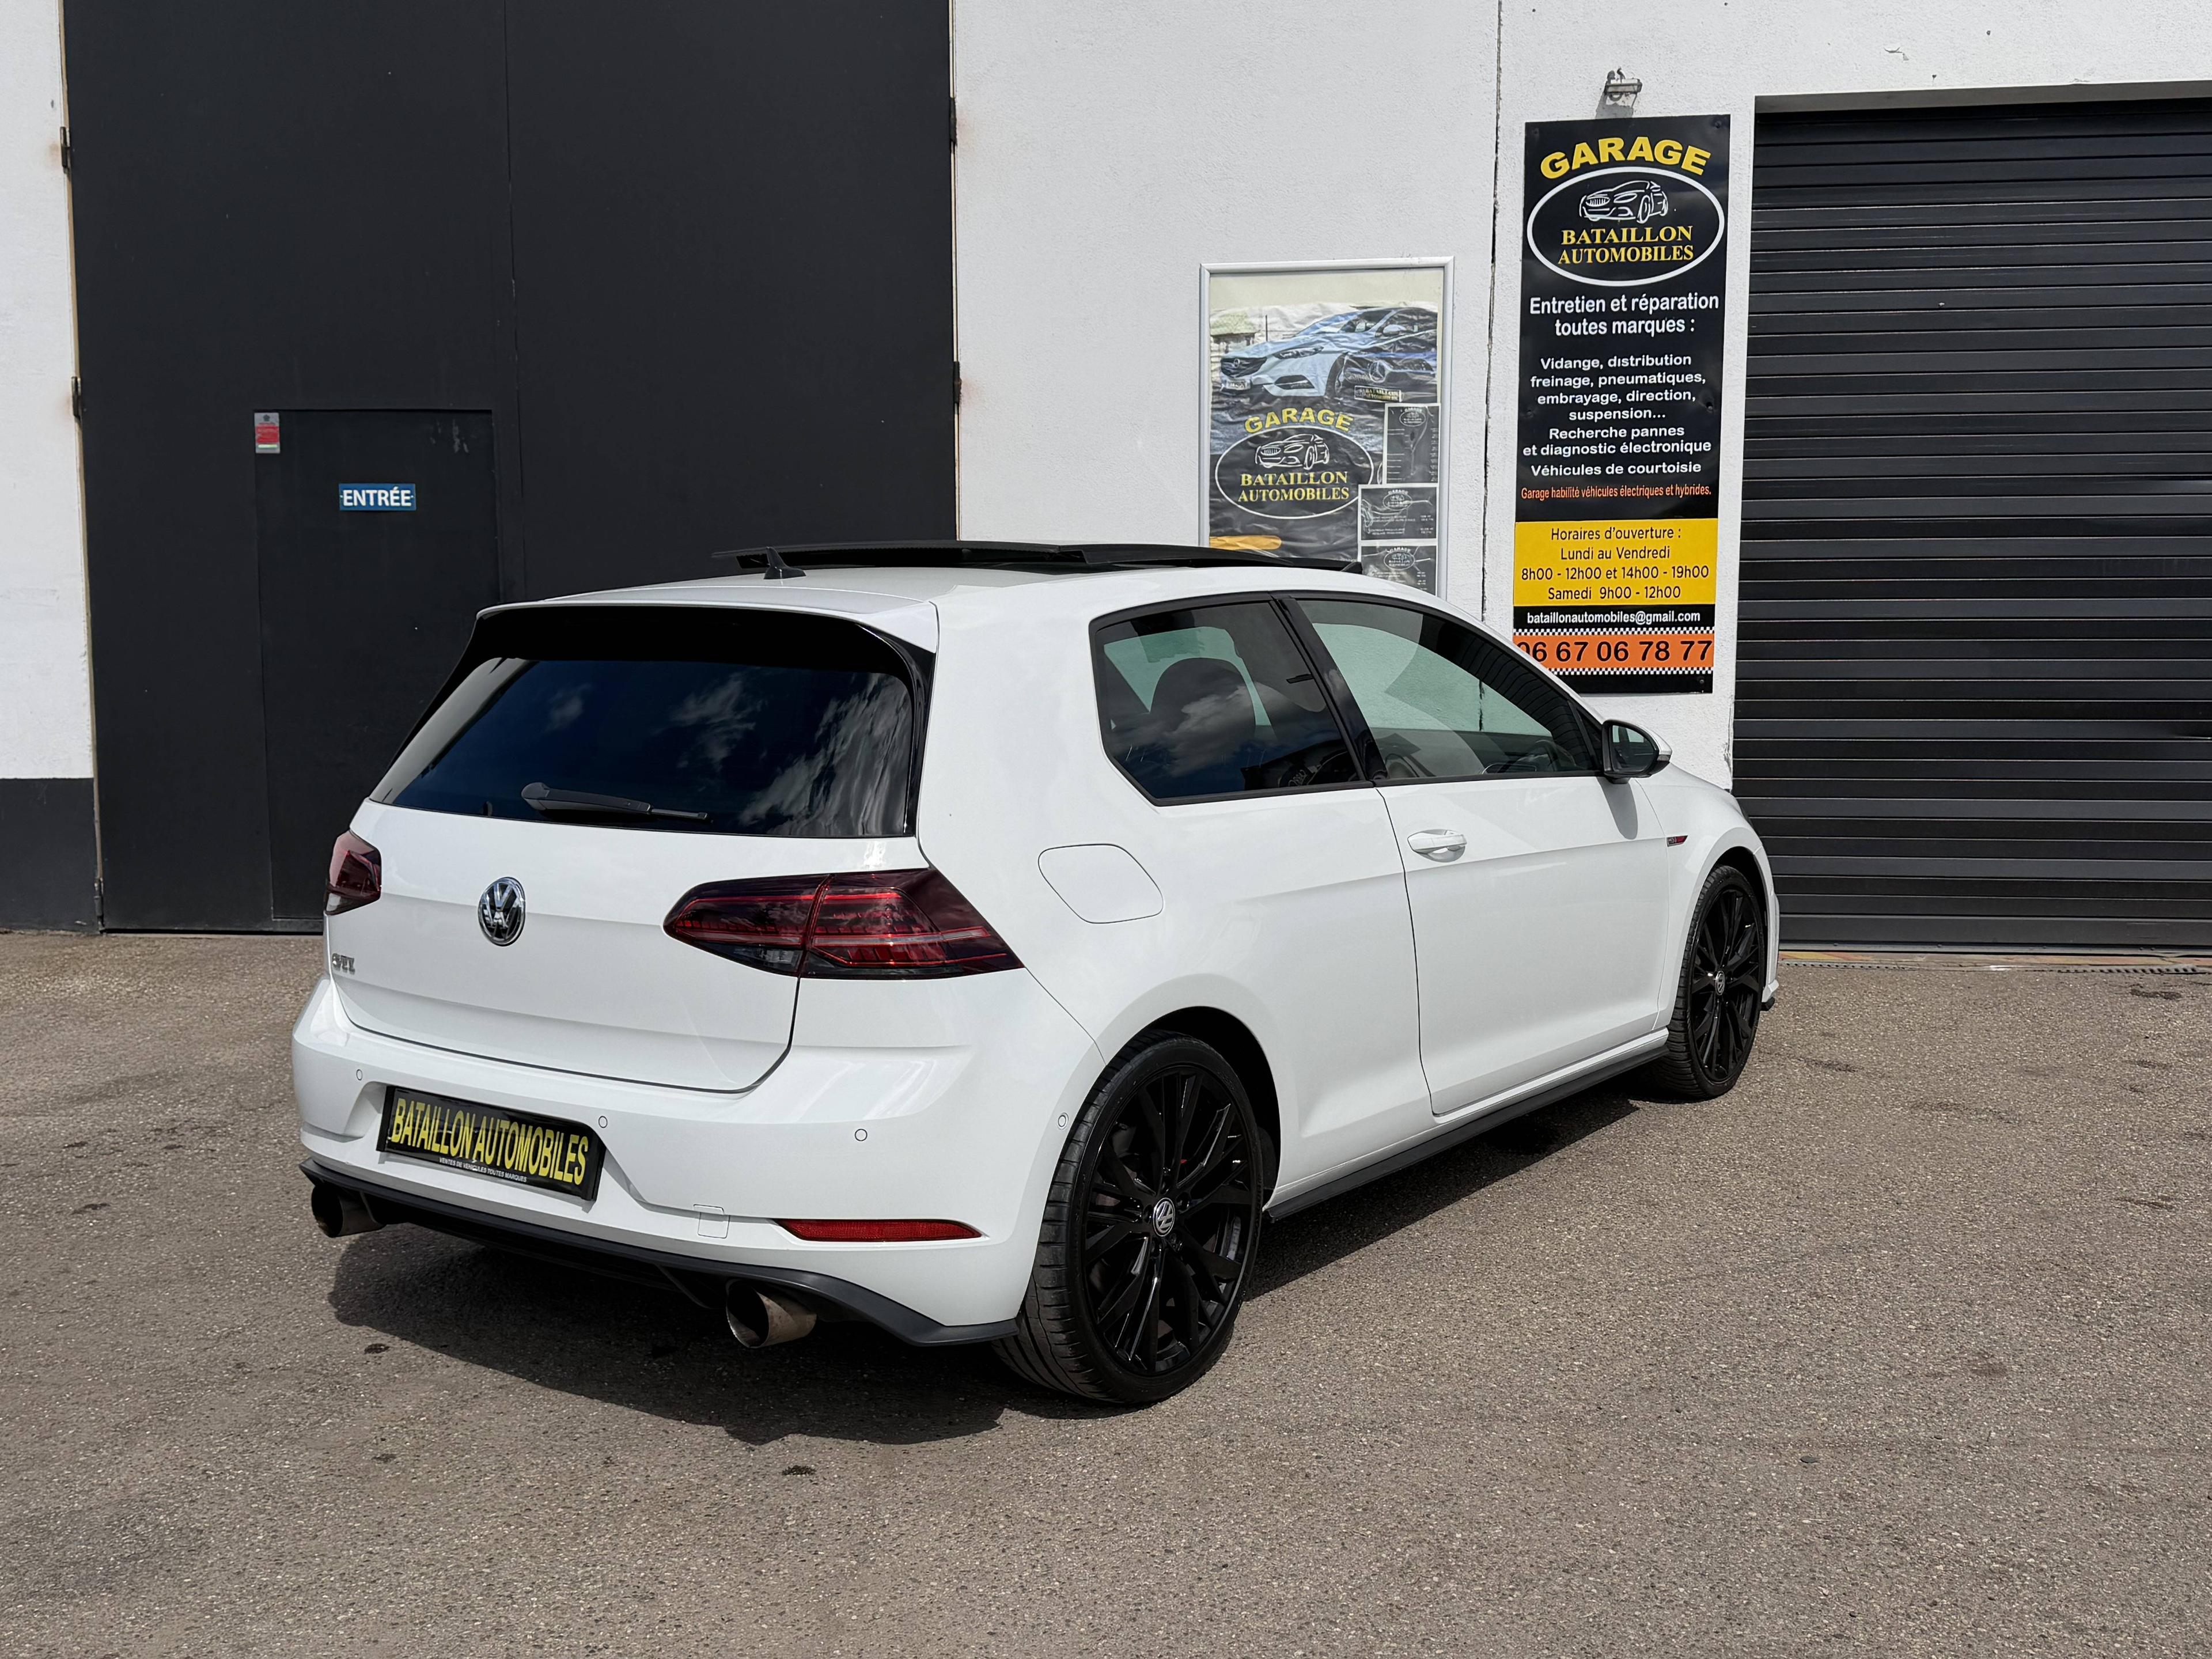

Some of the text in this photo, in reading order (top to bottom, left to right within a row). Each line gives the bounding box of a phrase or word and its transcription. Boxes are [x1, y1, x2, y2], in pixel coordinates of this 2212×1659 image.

[1540, 137, 1711, 179] GARAGE
[1561, 225, 1693, 245] BATAILLON
[1558, 245, 1694, 264] AUTOMOBILES
[1530, 293, 1719, 314] Entretien et réparation
[1555, 319, 1607, 336] toutes
[1612, 319, 1685, 338] marques
[1541, 354, 1691, 371] Vidange, distribution
[1531, 373, 1706, 388] freinage, pneumatiques,
[1537, 389, 1696, 406] embrayage, direction,
[1244, 407, 1354, 433] GARAGE
[1569, 408, 1666, 422] suspension...
[1549, 427, 1684, 440] Recherche pannes
[1523, 440, 1711, 457] et diagnostic électronique
[1531, 461, 1701, 476] Véhicules de courtoisie
[1240, 471, 1349, 486] BATAILLON
[343, 486, 411, 506] ENTRÉE
[1238, 487, 1349, 502] AUTOMOBILES
[1521, 484, 1711, 501] Garage habilité véhicules électriques et hybrides.
[1551, 527, 1600, 540] Horaires
[1560, 546, 1670, 560] Lundi au Vendredi
[1521, 568, 1553, 580] 8h00
[1566, 567, 1601, 579] 12h00
[1605, 568, 1617, 578] et
[1622, 567, 1658, 579] 14h00
[1672, 566, 1709, 578] 19h00
[1548, 587, 1592, 600] Samedi
[1599, 587, 1631, 599] 9h00
[1645, 586, 1680, 599] 12h00
[1527, 611, 1700, 624] bataillonautomobiles@gmail.com
[1556, 641, 1589, 662] 67
[1597, 641, 1629, 661] 06
[1639, 641, 1669, 661] 78
[1680, 640, 1712, 661] 77
[391, 1098, 589, 1185] BATAILLON AUTOMOBILES
[487, 1168, 504, 1177] TOUTES
